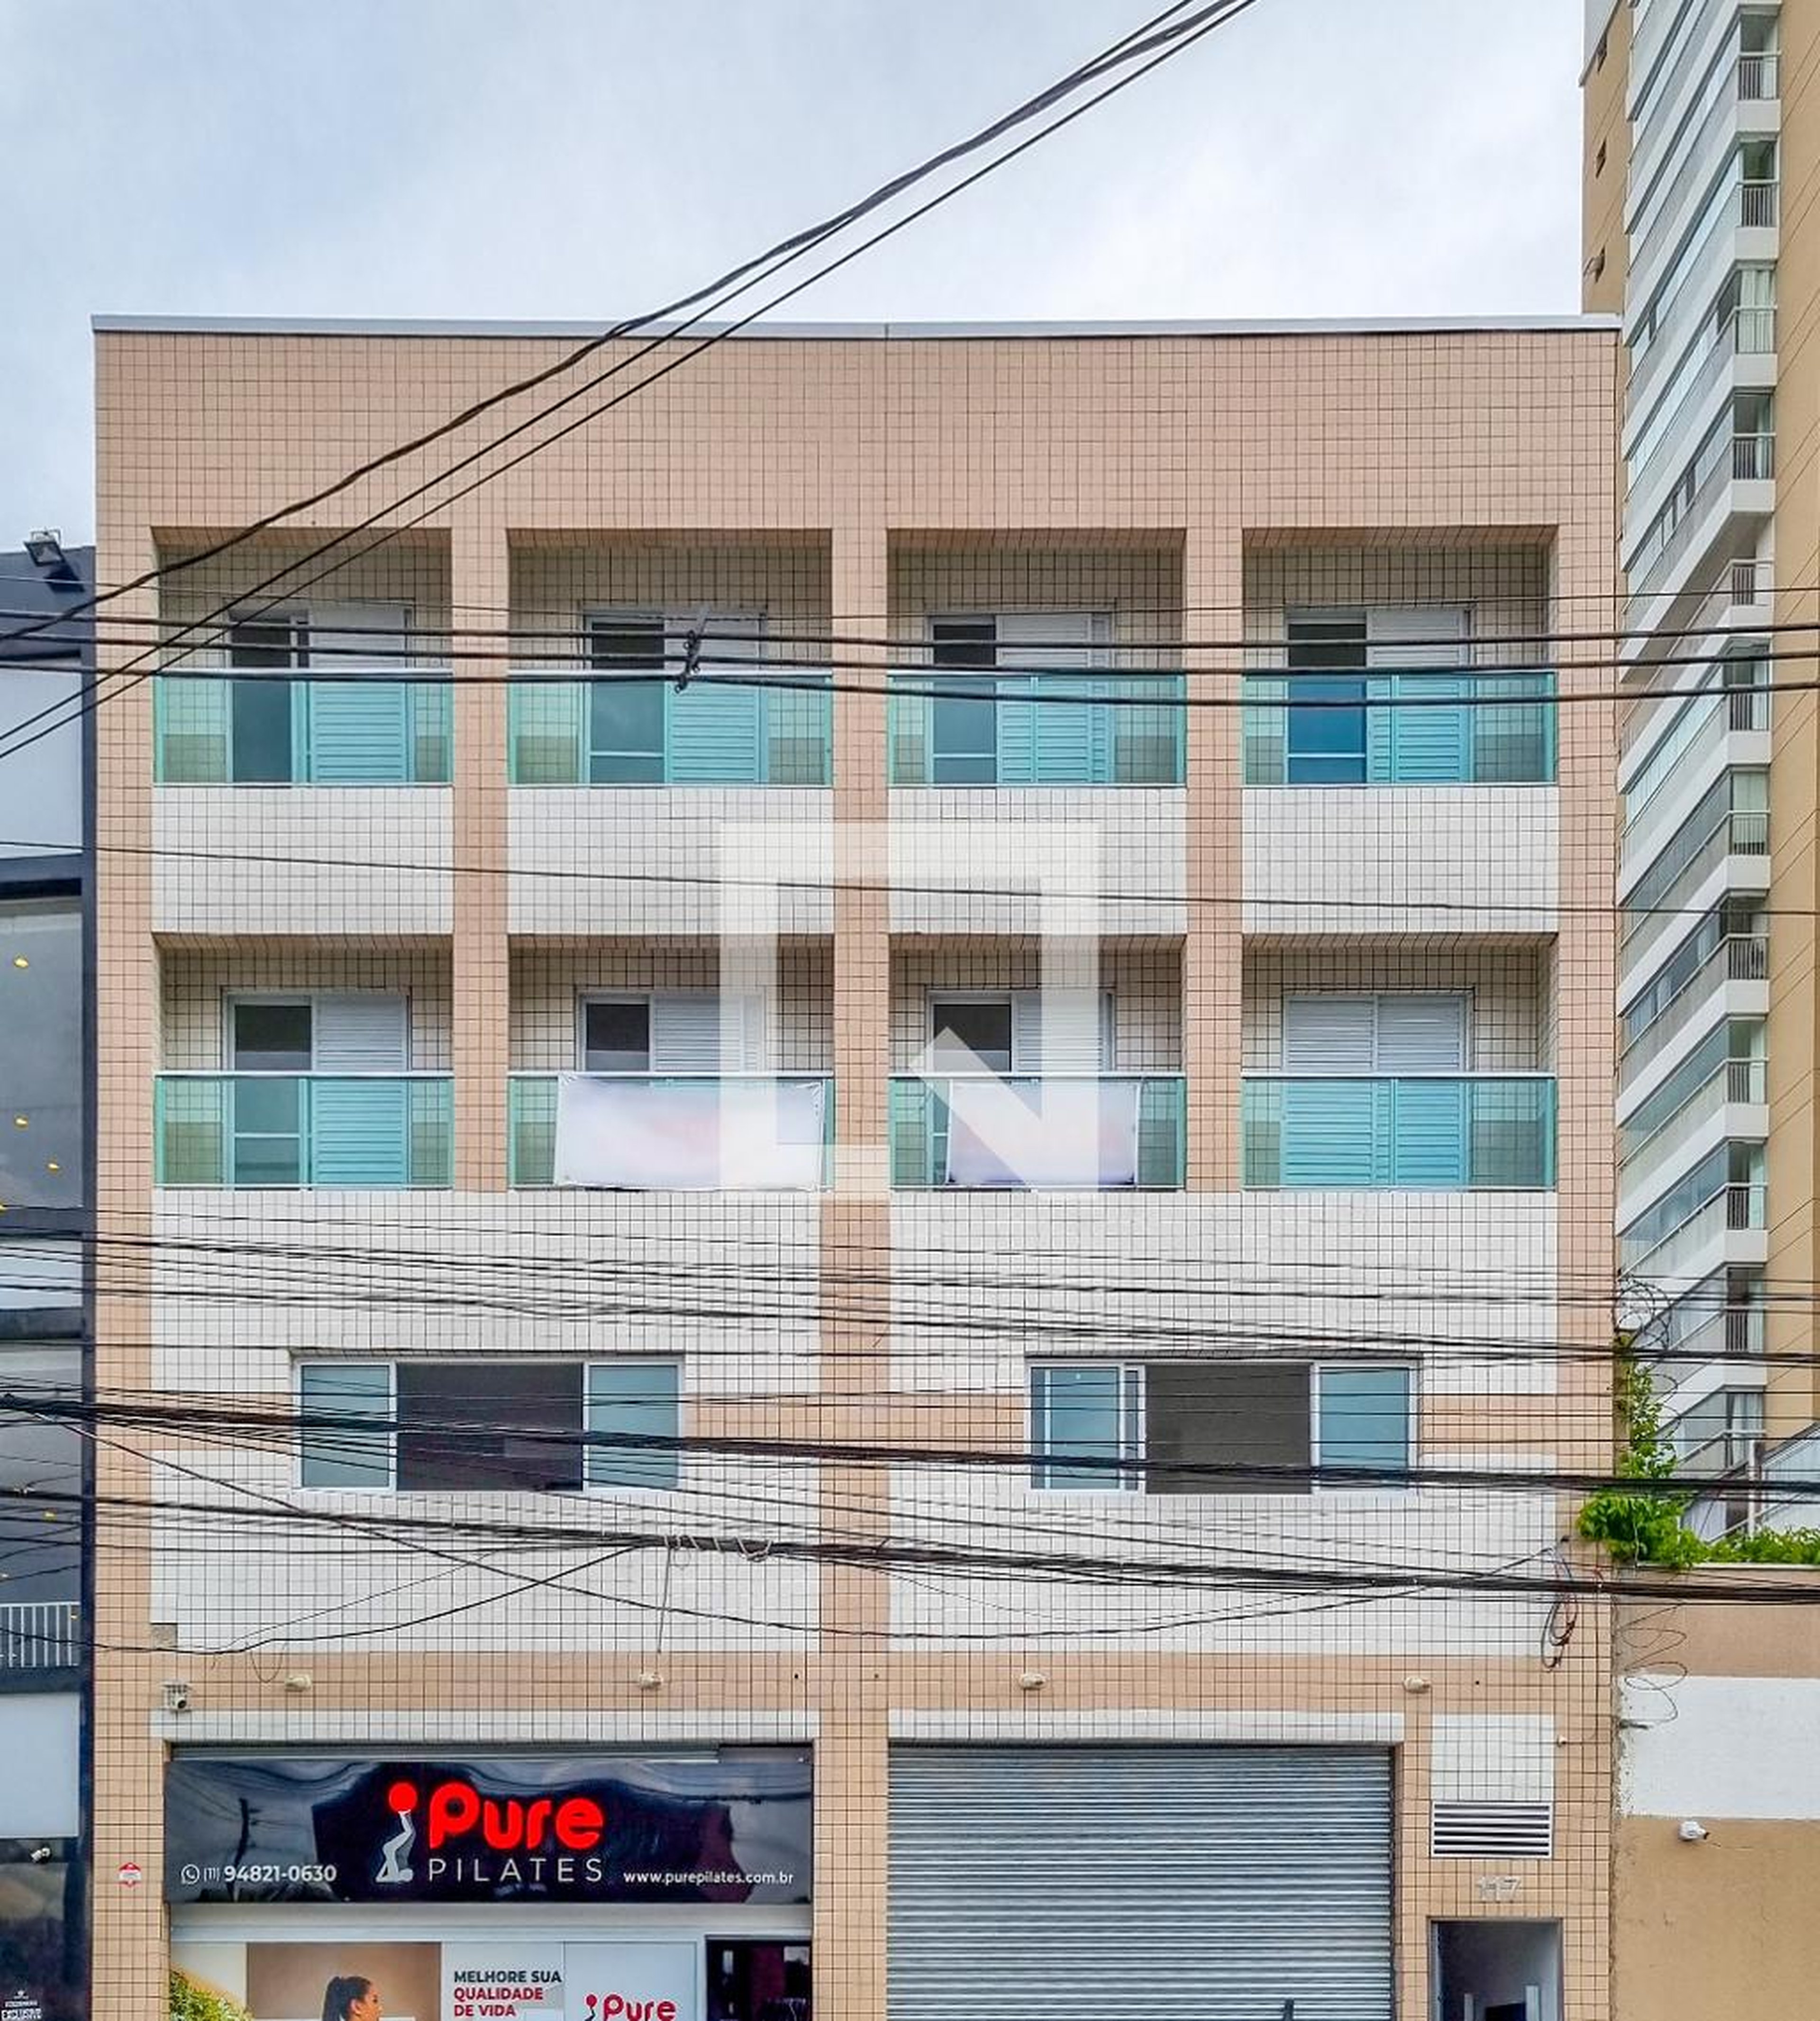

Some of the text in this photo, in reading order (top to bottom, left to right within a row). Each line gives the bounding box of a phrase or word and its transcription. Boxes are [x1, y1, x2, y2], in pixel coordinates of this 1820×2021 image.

[429, 1782, 603, 1848] Pure
[224, 1866, 337, 1882] 94821-0630
[429, 1858, 602, 1882] PILATES
[623, 1871, 794, 1885] www.purepilates.com.br
[454, 1970, 562, 1983] MELHORE SUA
[454, 1987, 543, 2001] QUALIDADE
[454, 2004, 516, 2016] DE VIDA
[603, 1994, 676, 2021] Pure
